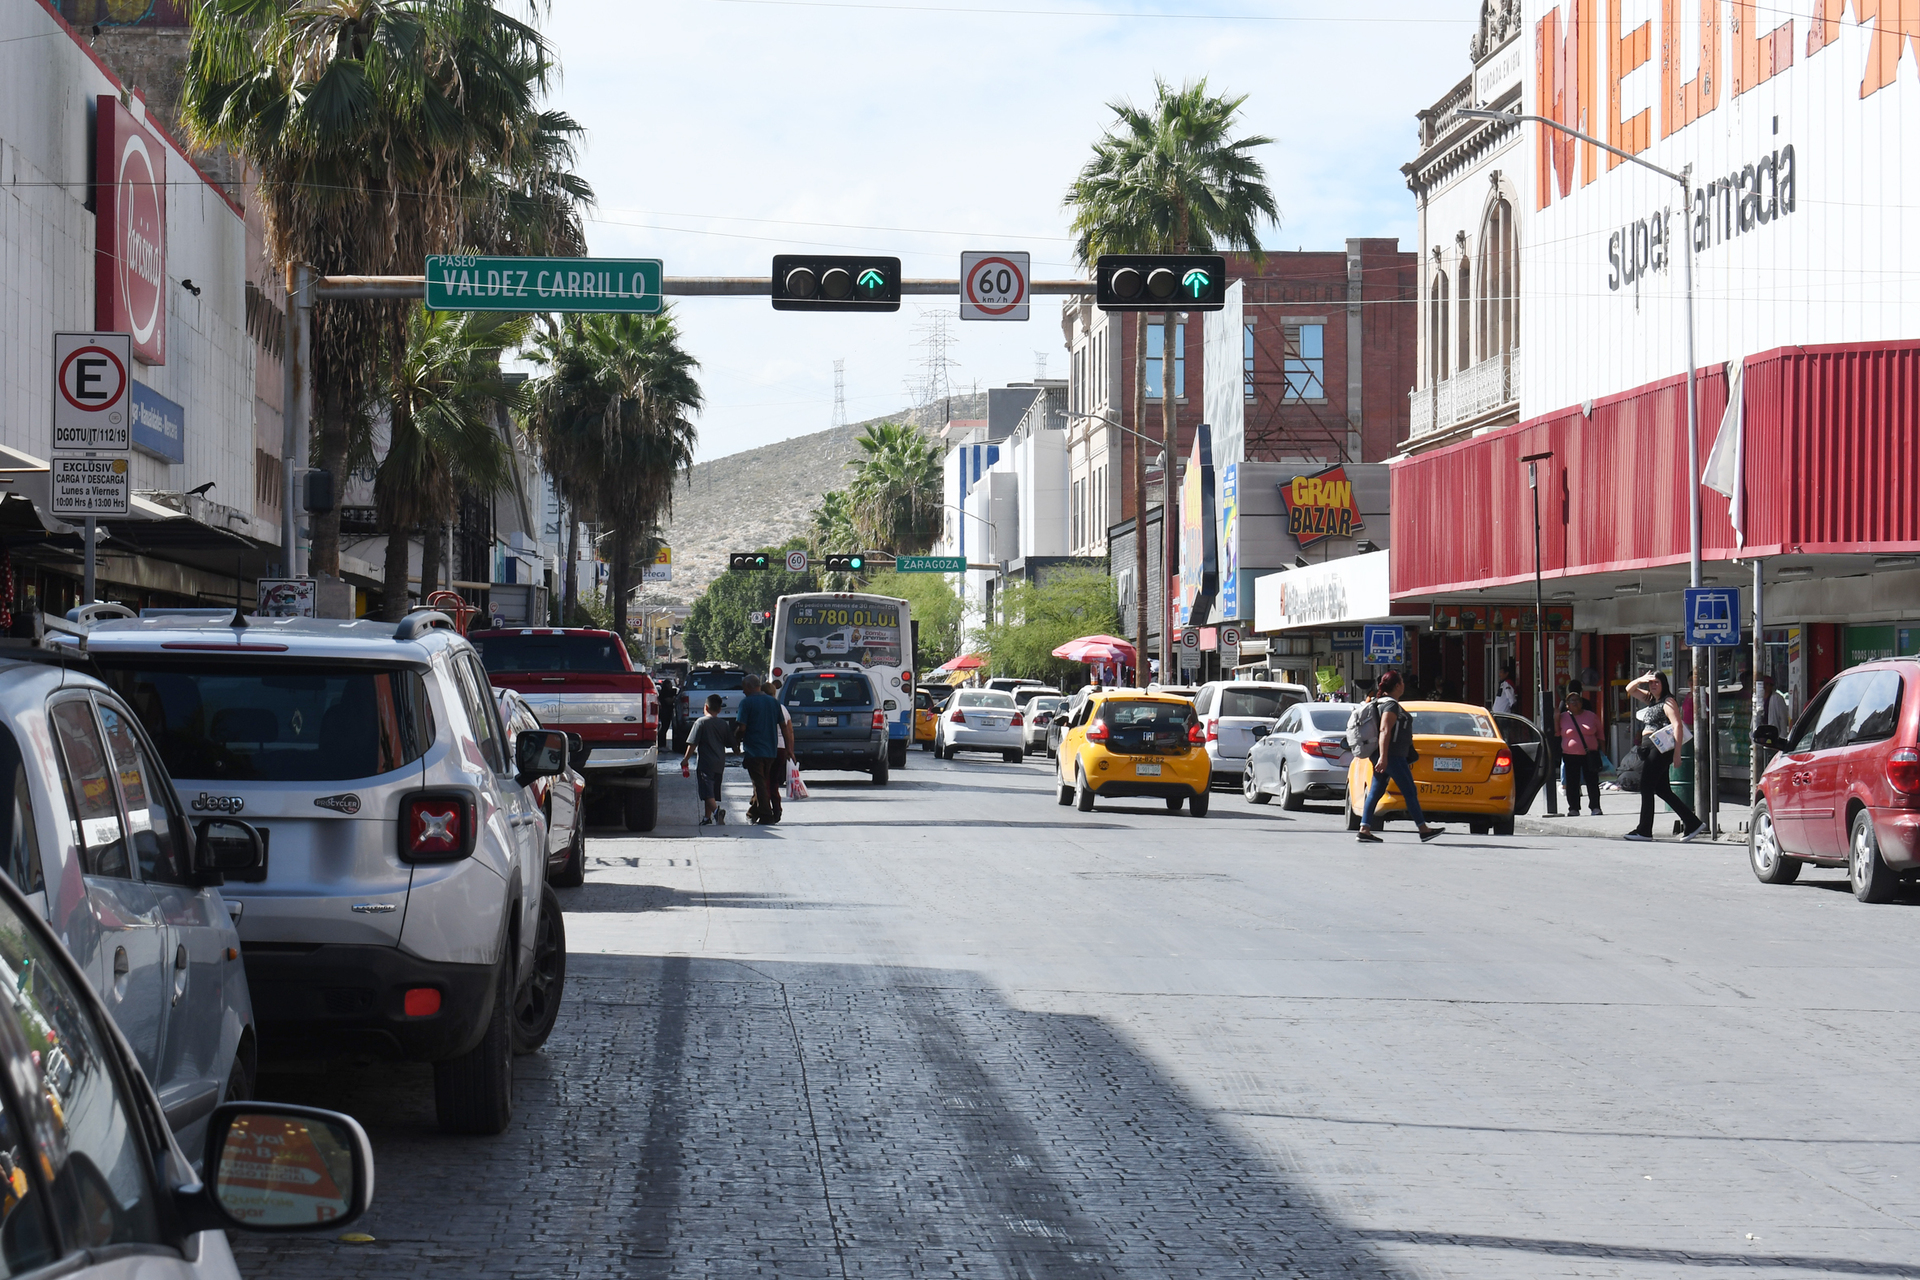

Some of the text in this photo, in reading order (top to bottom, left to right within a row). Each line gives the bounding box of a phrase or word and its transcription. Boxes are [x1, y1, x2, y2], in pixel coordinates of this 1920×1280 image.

[1503, 57, 1509, 80] EN
[1678, 114, 1796, 254] armacia
[127, 177, 160, 289] Parisina
[438, 256, 476, 267] PASEO
[443, 269, 646, 299] VALDEZ CARRILLO
[979, 269, 1011, 294] 60
[76, 358, 108, 399] E
[57, 427, 126, 443] DGOTU/IT/112/19
[63, 462, 113, 472] EXCLUSIV
[56, 473, 125, 484] CARGA Y DESCARGA
[61, 485, 84, 495] Lunes
[91, 486, 119, 496] Viernes
[1292, 476, 1352, 508] GRAN
[56, 497, 73, 506] 10:00
[74, 497, 86, 507] Hrs
[94, 498, 111, 508] 13:00
[113, 498, 124, 508] Hrs
[1289, 506, 1353, 536] BAZAR
[791, 555, 802, 564] 60
[903, 559, 959, 569] ZARAGOZA
[794, 609, 898, 627] (871) 780.01.01
[1187, 635, 1194, 644] E
[1227, 632, 1235, 642] E
[1851, 650, 1867, 661] TODOS
[576, 703, 616, 713] RANCH
[1143, 731, 1155, 741] FIAT
[1420, 784, 1474, 795] 871-722-22-20
[191, 792, 244, 814] Jeep
[316, 797, 358, 808] PROCYCLER
